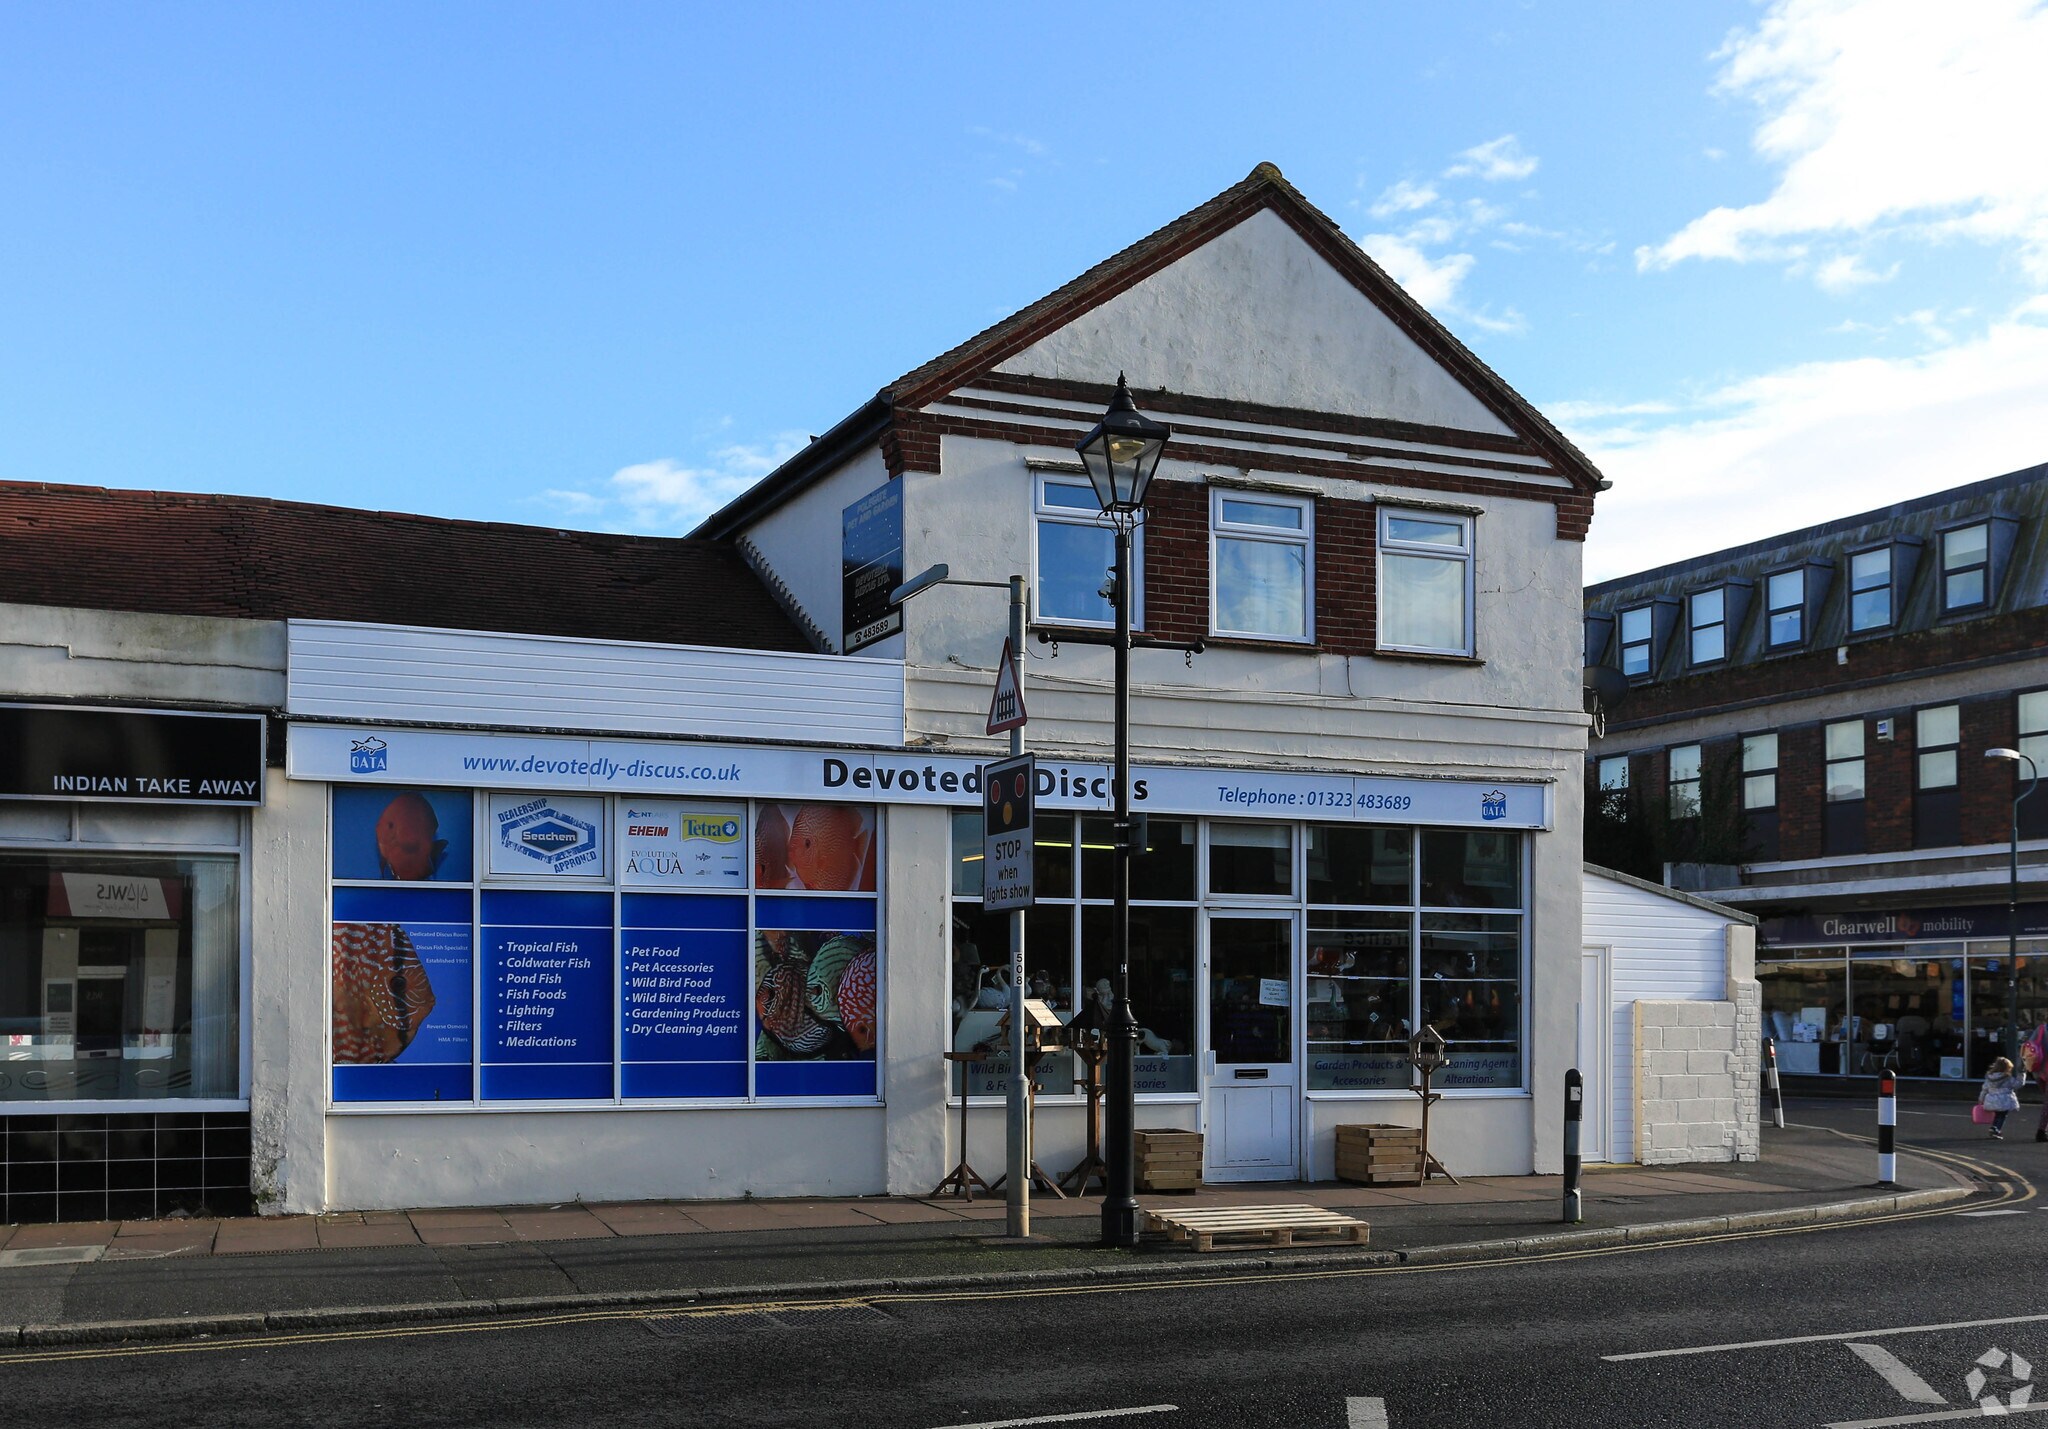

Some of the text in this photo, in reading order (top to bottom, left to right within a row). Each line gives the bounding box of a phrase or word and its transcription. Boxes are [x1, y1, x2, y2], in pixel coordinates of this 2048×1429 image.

[863, 620, 889, 639] 483689
[351, 756, 386, 770] OATA
[463, 755, 741, 781] www.devotedly-discus.co.uk
[823, 758, 982, 794] Devoted
[54, 775, 257, 795] INDIAN TAKE AWAY
[1218, 787, 1296, 807] Telephone
[1307, 791, 1353, 807] 01323
[1357, 794, 1411, 810] 483689
[497, 798, 547, 823] DEALERSHIP
[1482, 807, 1506, 817] OATA
[628, 825, 669, 837] EHEIM
[683, 819, 721, 837] Tetra
[522, 831, 577, 842] Seachem
[631, 850, 678, 858] EVOLUTION
[995, 839, 1021, 861] STOP
[553, 850, 597, 874] APPROVED
[626, 858, 683, 877] AQUA
[998, 866, 1018, 881] when
[987, 884, 1030, 904] lights show
[1822, 916, 1974, 936] Clearwell mobility
[506, 941, 578, 954] Tropical Fish
[631, 946, 680, 957] Pet Food
[506, 957, 591, 969] Coldwater Fish
[631, 962, 714, 973] Pet Accessories
[506, 973, 562, 984] Pond Fish
[632, 977, 712, 988] Wild Bird Food
[506, 989, 567, 1000] Fish Foods
[632, 993, 726, 1003] Wild Bird Feeders
[506, 1005, 555, 1018] Lighting
[631, 1008, 741, 1021] Gardening Products
[506, 1020, 542, 1031] Filters
[631, 1023, 738, 1036] Dry Cleaning Agent
[506, 1036, 577, 1047] Medications
[970, 1063, 995, 1074] Wild
[1035, 1063, 1054, 1074] ods
[1134, 1061, 1168, 1073] oods &
[1314, 1060, 1350, 1070] Garden
[1352, 1059, 1394, 1070] Products
[1482, 1058, 1509, 1070] Agent
[1332, 1075, 1386, 1086] Accessories
[1444, 1074, 1494, 1084] Alterations
[986, 1081, 995, 1090] &
